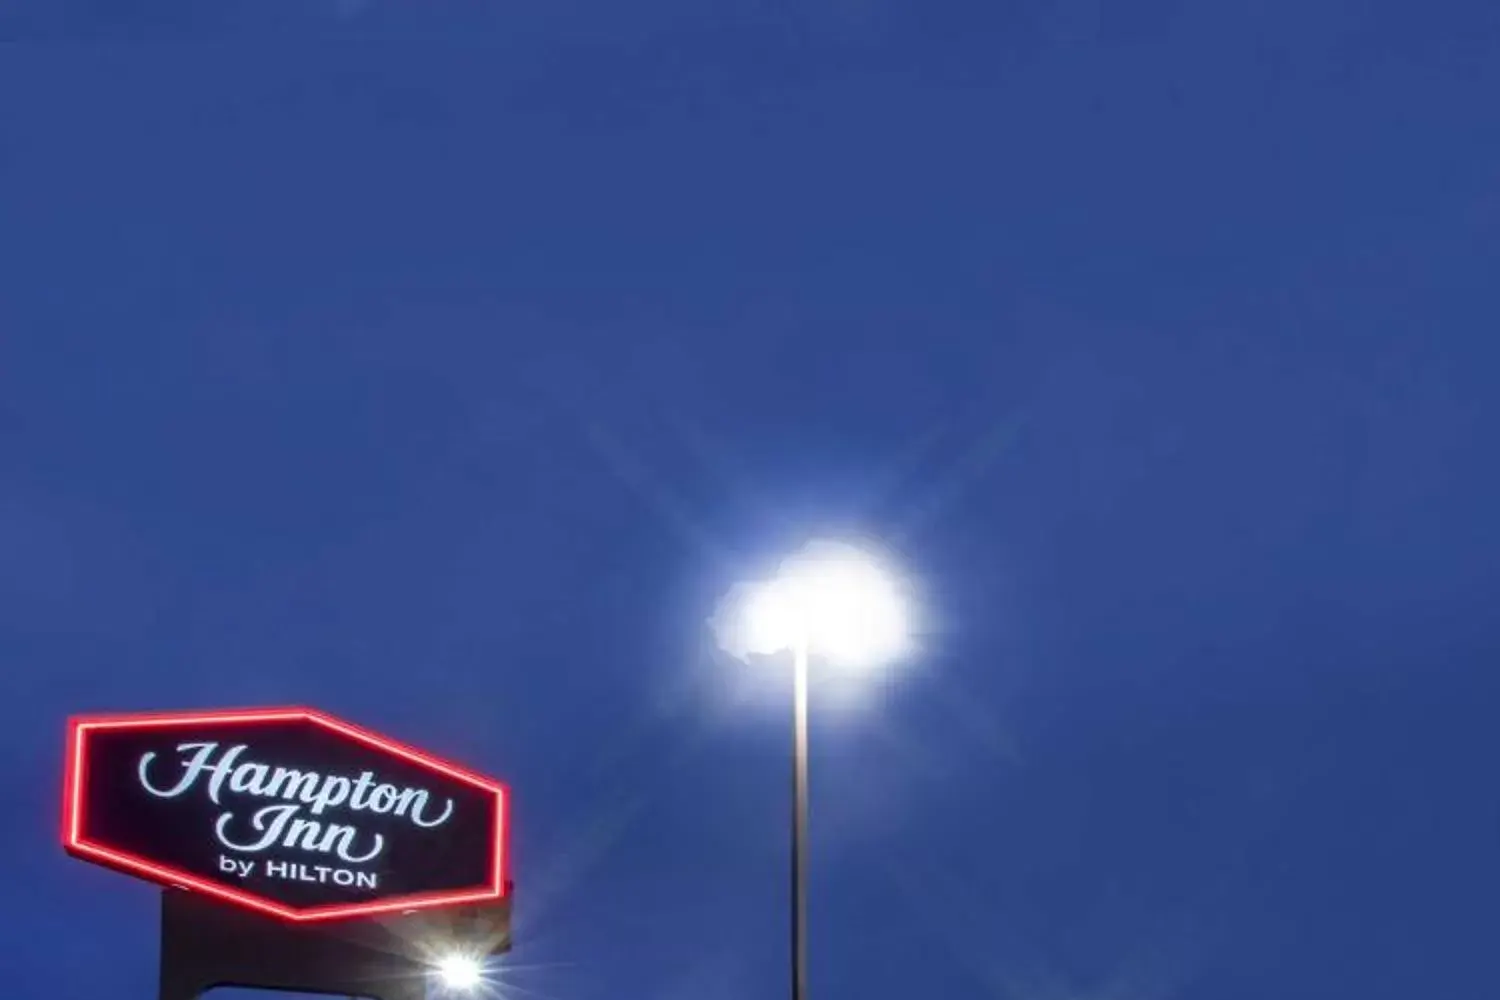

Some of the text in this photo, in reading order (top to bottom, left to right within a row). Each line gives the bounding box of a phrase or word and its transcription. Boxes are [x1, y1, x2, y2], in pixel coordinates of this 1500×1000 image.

[138, 742, 453, 827] Hampton
[215, 804, 384, 862] Inn
[219, 854, 378, 889] by HILTON
